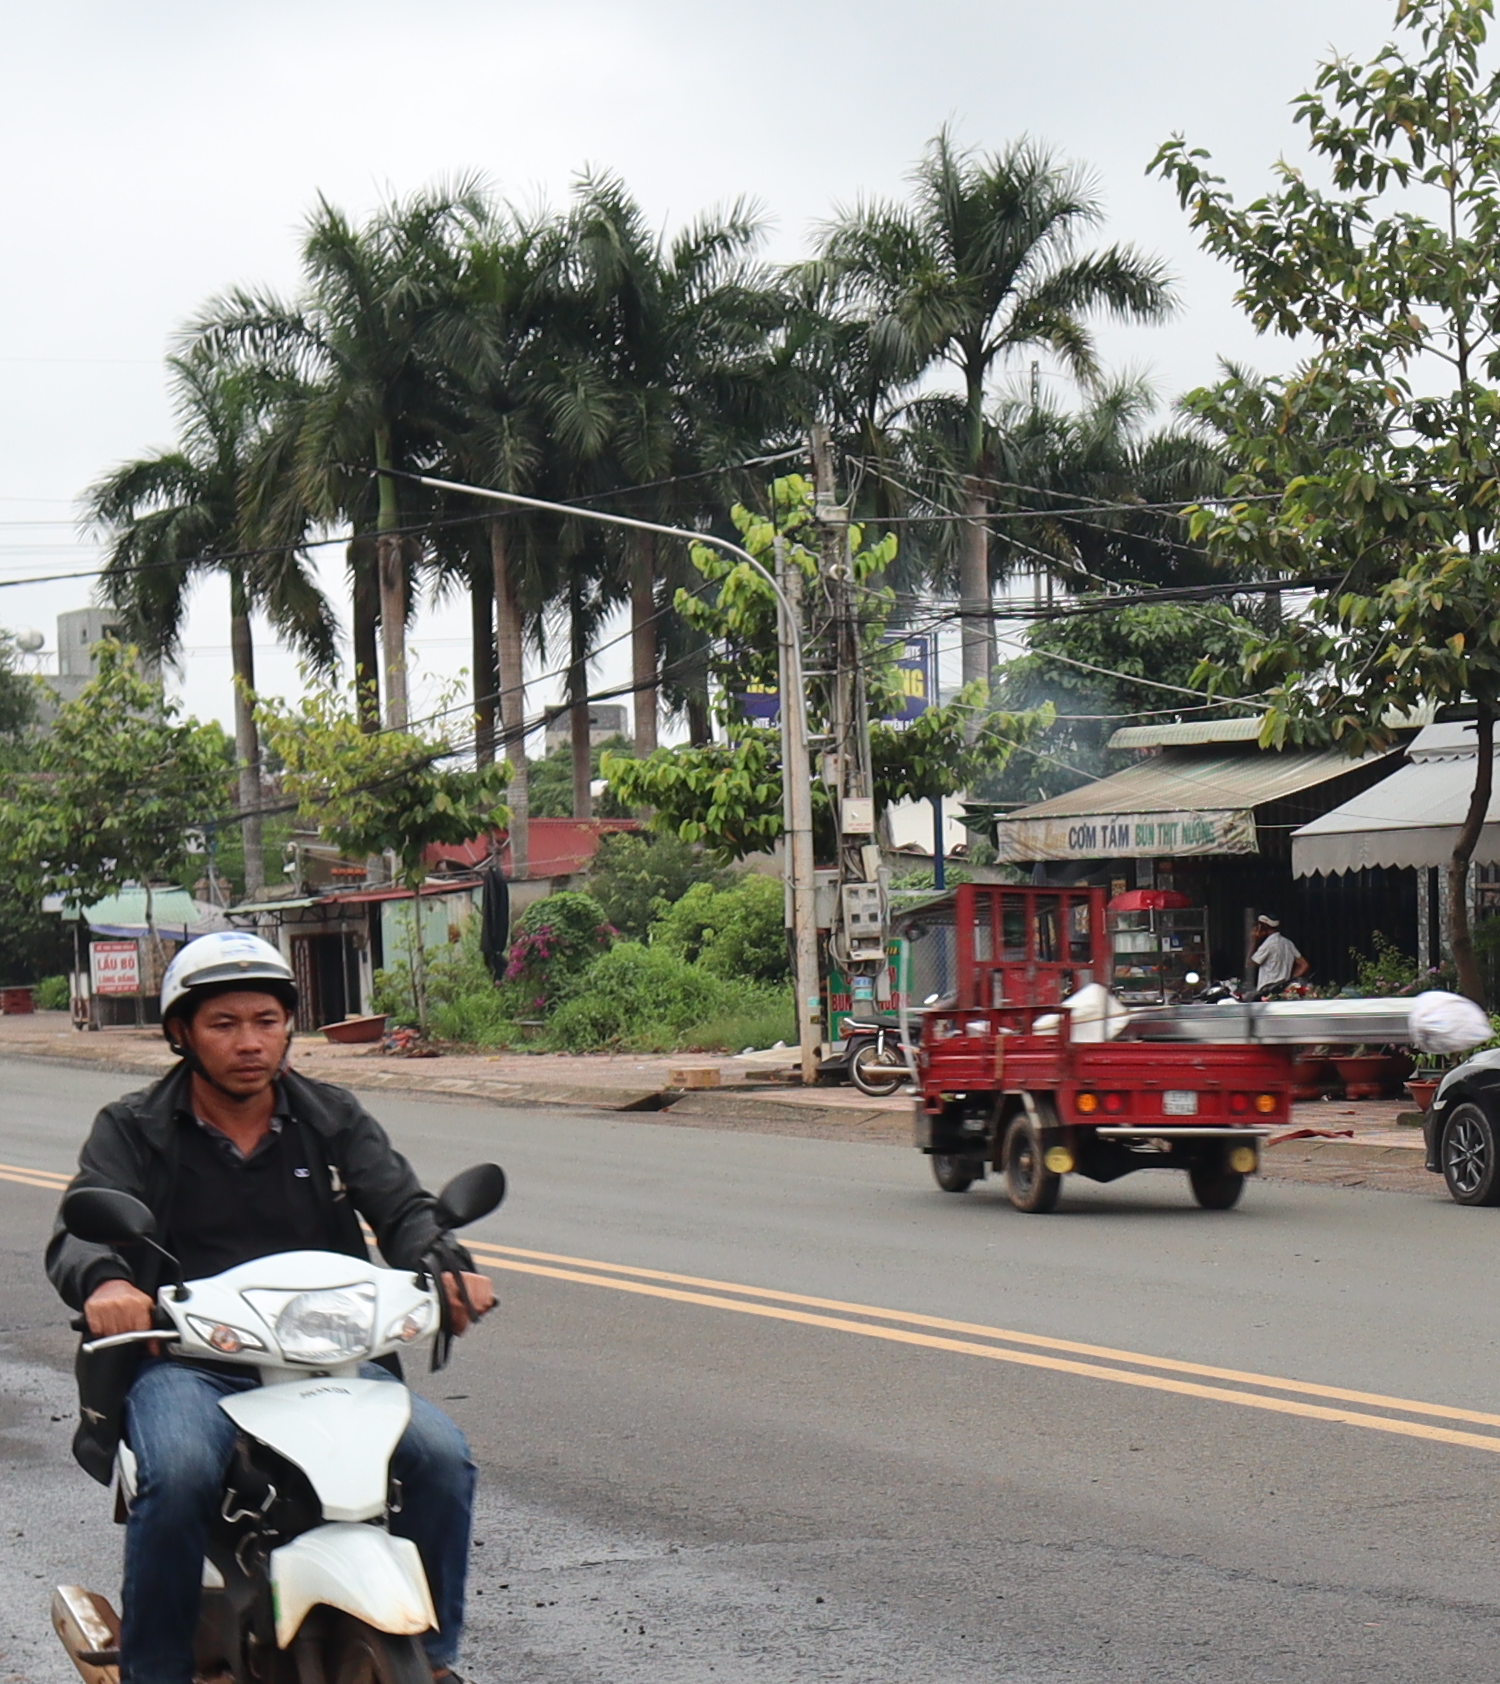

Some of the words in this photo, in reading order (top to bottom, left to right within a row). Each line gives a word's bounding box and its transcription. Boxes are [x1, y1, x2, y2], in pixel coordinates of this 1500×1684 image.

[1068, 824, 1096, 849] CƠM
[1101, 816, 1129, 849] TẤM
[1135, 818, 1154, 847] BÚN
[1157, 823, 1178, 851] THỊT
